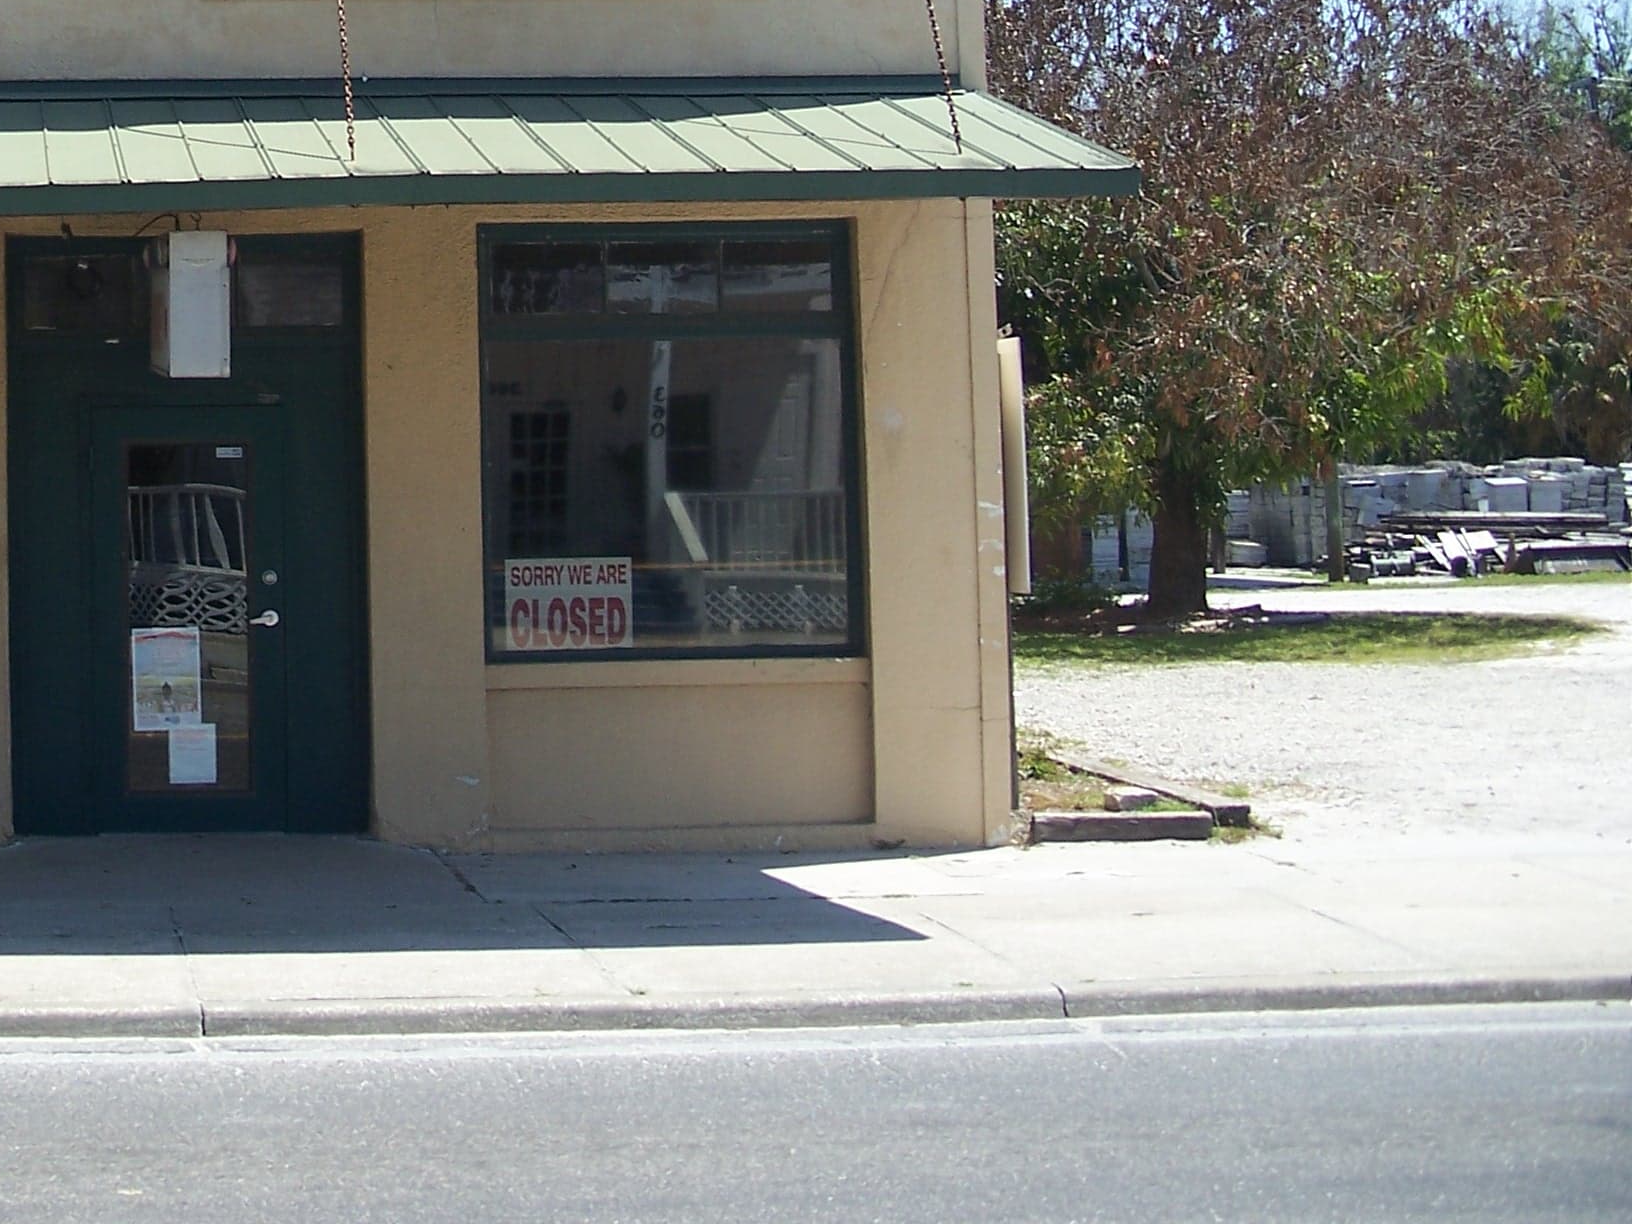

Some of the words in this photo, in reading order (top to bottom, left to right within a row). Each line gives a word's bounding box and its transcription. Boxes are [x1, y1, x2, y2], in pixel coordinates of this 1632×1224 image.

[510, 565, 563, 587] SORRY
[568, 565, 593, 585] WE
[596, 564, 627, 585] ARE
[511, 597, 626, 648] CLOSED
